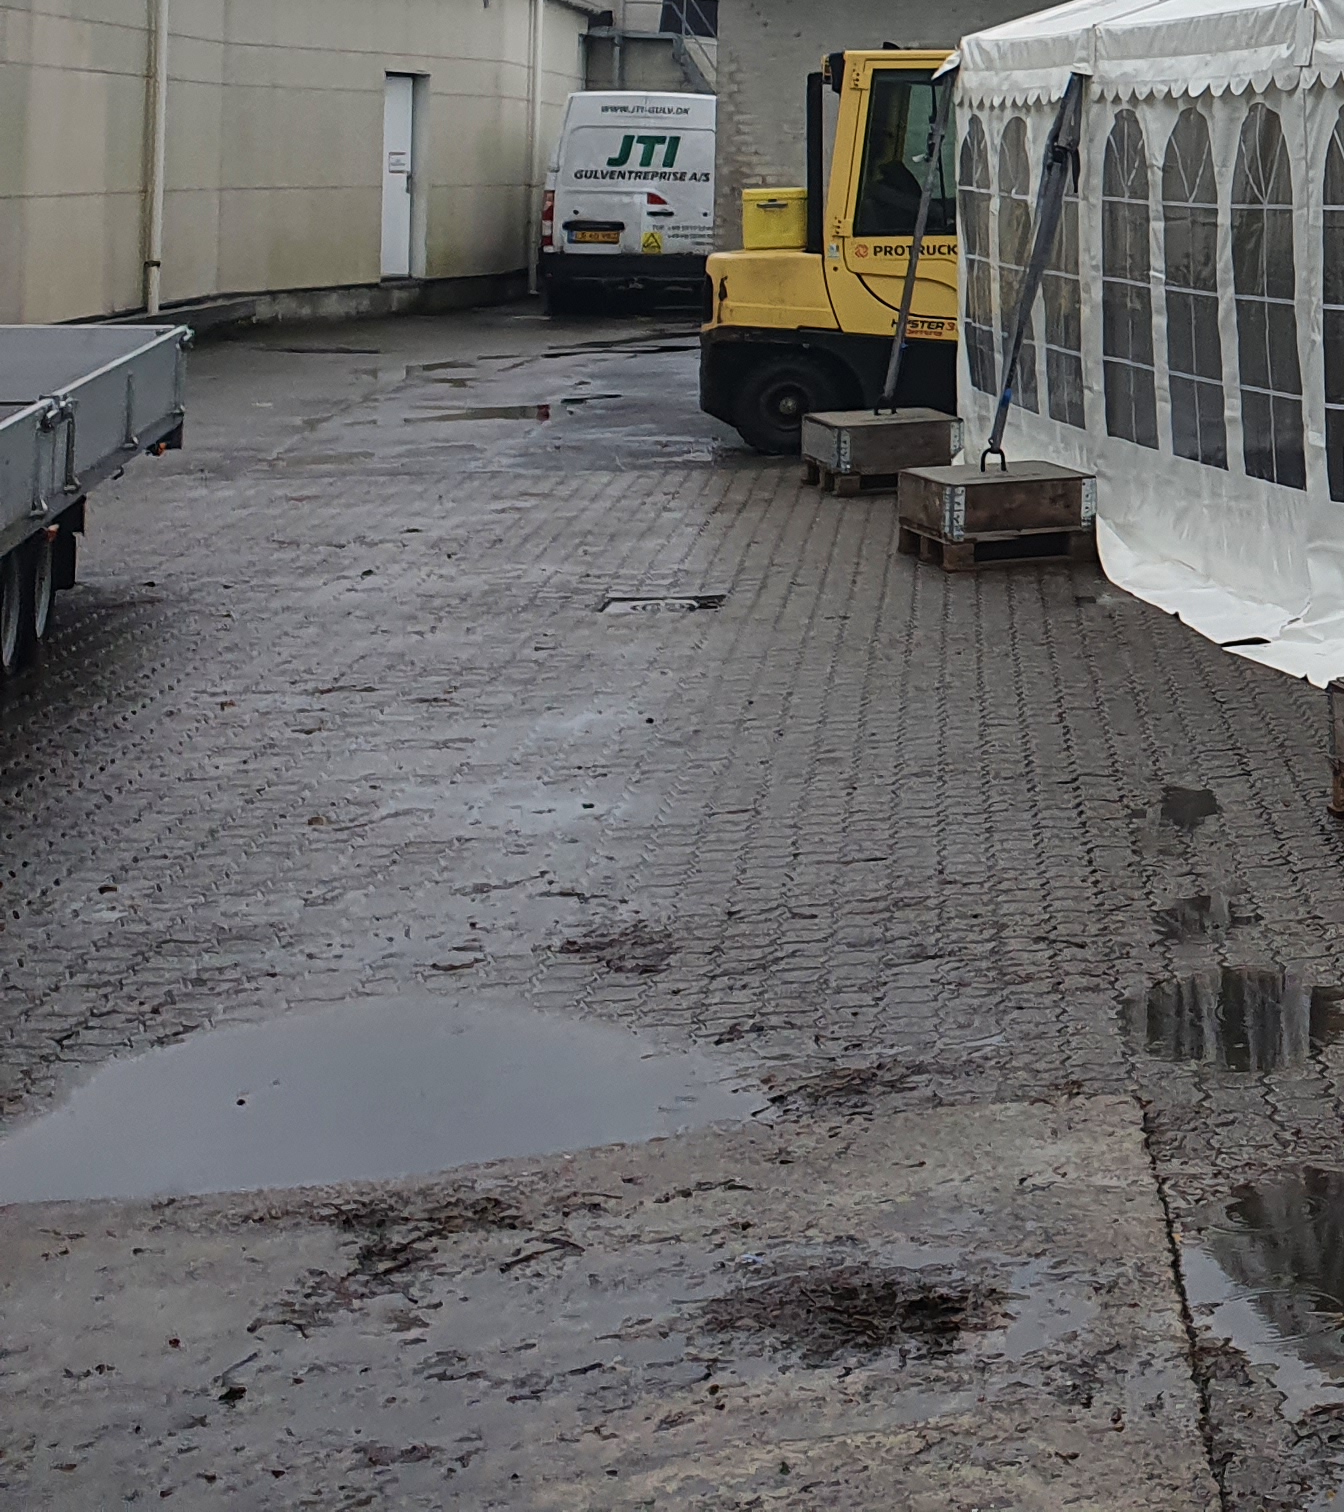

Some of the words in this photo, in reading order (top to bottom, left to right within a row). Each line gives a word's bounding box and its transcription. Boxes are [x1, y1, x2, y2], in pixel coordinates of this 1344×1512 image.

[606, 135, 680, 167] JTI
[574, 169, 686, 182] GULVENTREPRISE
[689, 172, 710, 183] A/S
